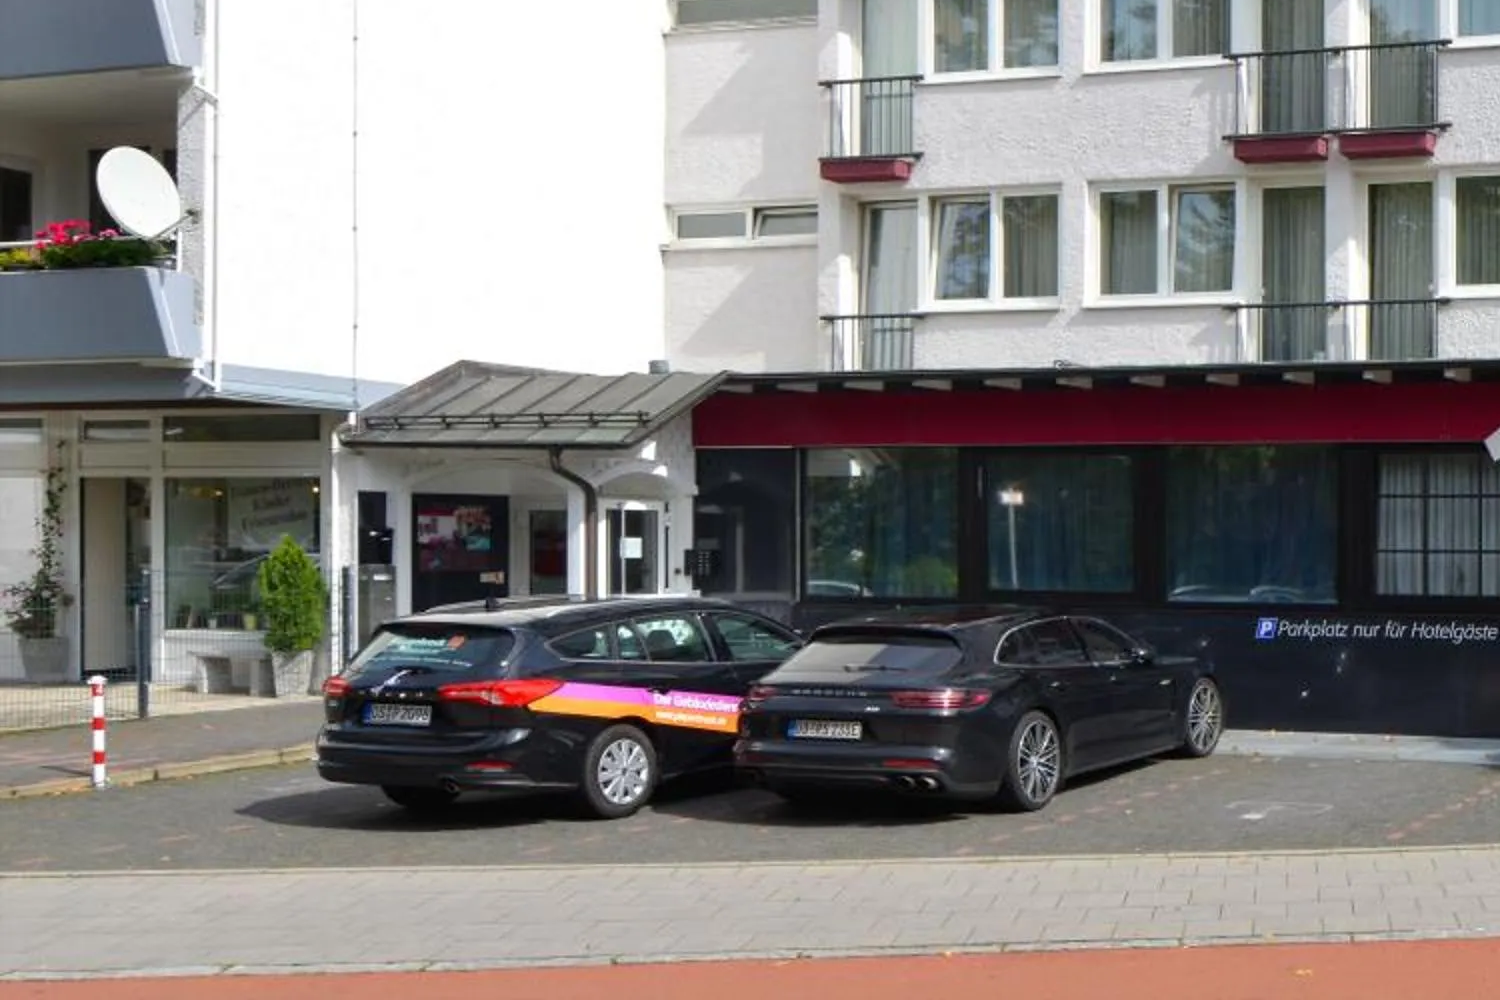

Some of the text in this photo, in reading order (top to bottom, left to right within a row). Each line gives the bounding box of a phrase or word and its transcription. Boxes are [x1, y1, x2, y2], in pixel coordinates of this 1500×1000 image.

[1277, 619, 1349, 642] Parkplatz
[1353, 623, 1381, 638] nur
[1384, 619, 1406, 638] für
[1410, 620, 1500, 645] Hotelgäste
